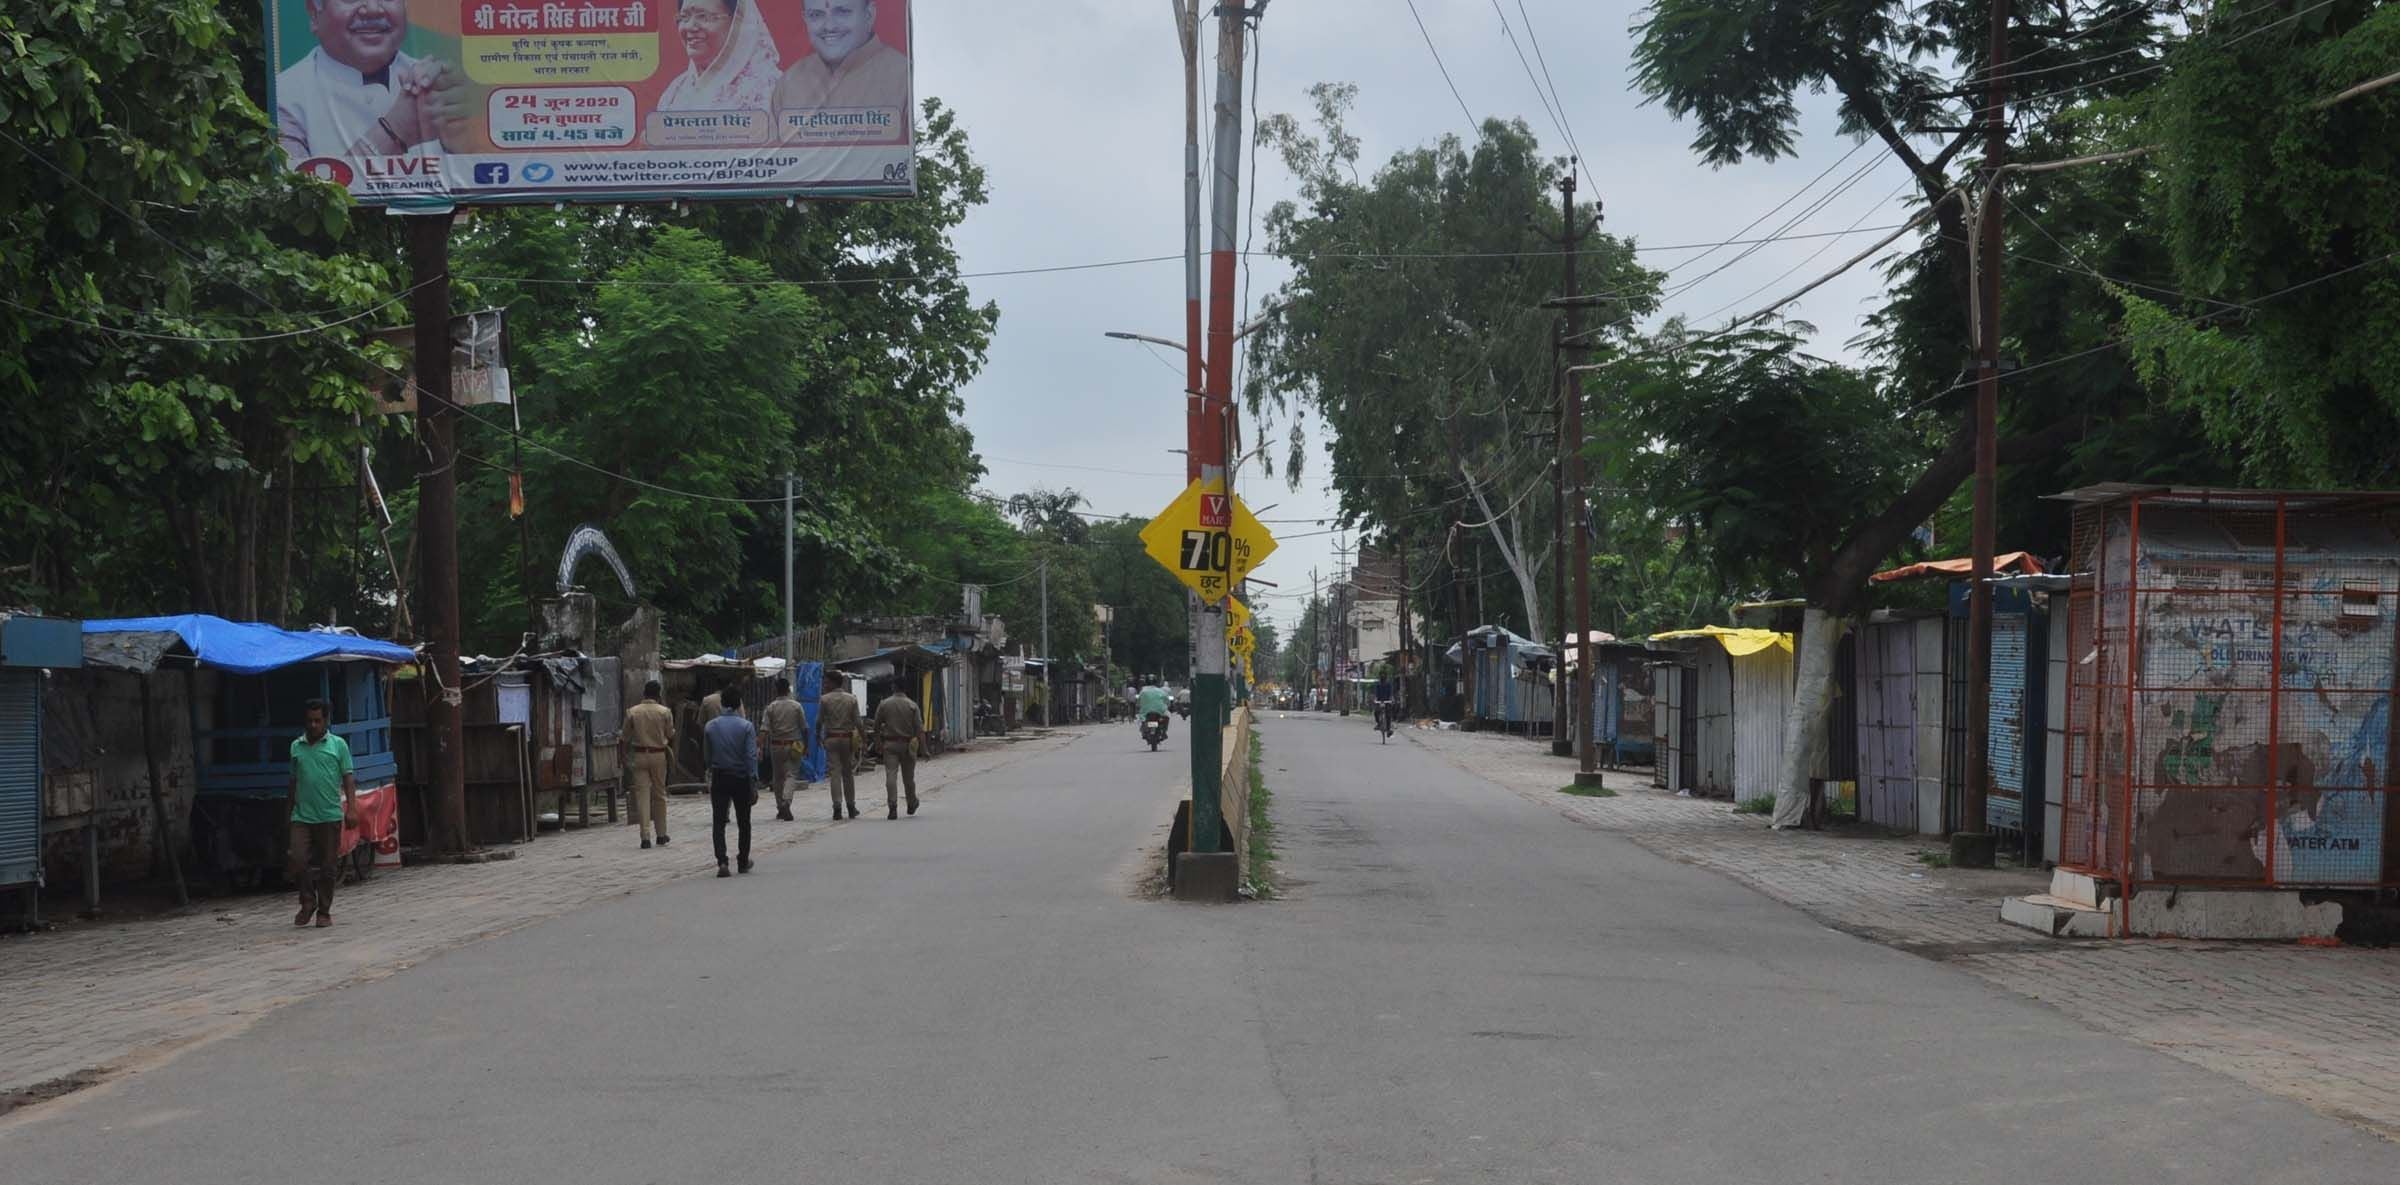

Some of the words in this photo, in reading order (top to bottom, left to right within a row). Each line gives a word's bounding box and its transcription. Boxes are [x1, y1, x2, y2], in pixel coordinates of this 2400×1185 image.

[474, 3, 495, 30] श्री
[499, 4, 539, 29] नरेन्द्र
[543, 1, 575, 29] सिंह
[579, 3, 619, 28] तोमर
[623, 2, 646, 27] जी
[504, 95, 537, 109] 24
[544, 97, 570, 111] जून
[575, 97, 619, 108] 2020
[522, 113, 550, 125] दिन
[555, 113, 602, 127] बुधवार
[663, 115, 720, 127] प्रेमलता
[722, 113, 751, 128] सिंह
[866, 110, 891, 126] सिंह
[501, 127, 538, 141] सायं
[542, 129, 588, 141] 4.45
[594, 126, 624, 140] बजे
[365, 157, 441, 176] LIVE
[563, 157, 799, 172] www.facebook.com/BJP4UP
[564, 168, 778, 183] www.twitter.com/BJP4UP
[366, 180, 443, 191] STREAMING
[1207, 496, 1224, 515] V
[1202, 515, 1231, 525] MAR
[1186, 532, 1232, 571] 70
[1234, 538, 1250, 557] %
[2330, 837, 2360, 850] ATM
